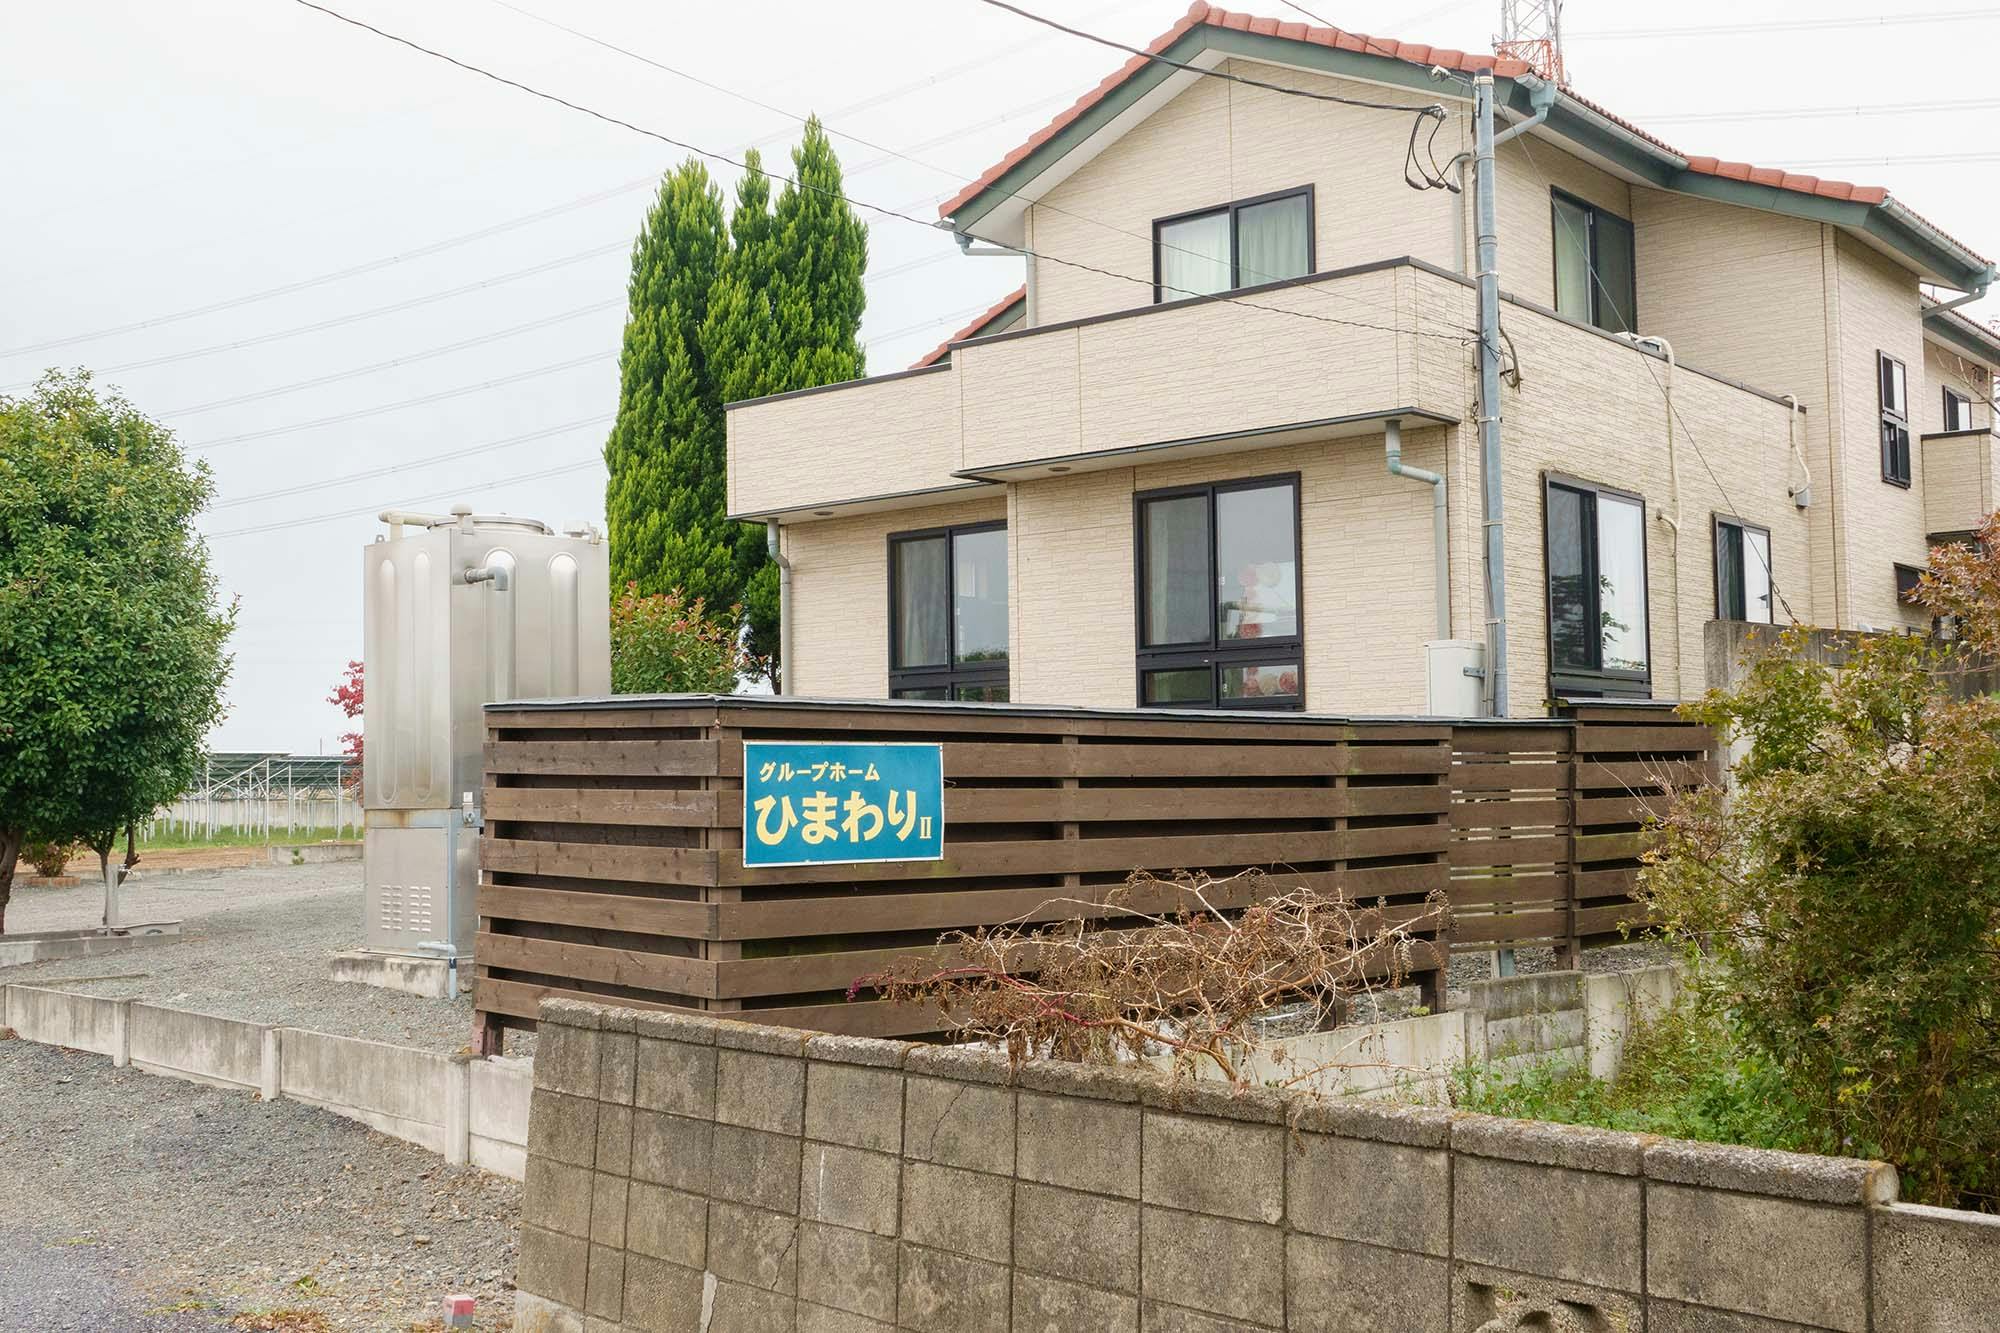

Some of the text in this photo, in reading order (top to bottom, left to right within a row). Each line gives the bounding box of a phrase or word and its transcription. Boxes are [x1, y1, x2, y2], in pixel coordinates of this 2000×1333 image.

[759, 761, 880, 783] グループホーム
